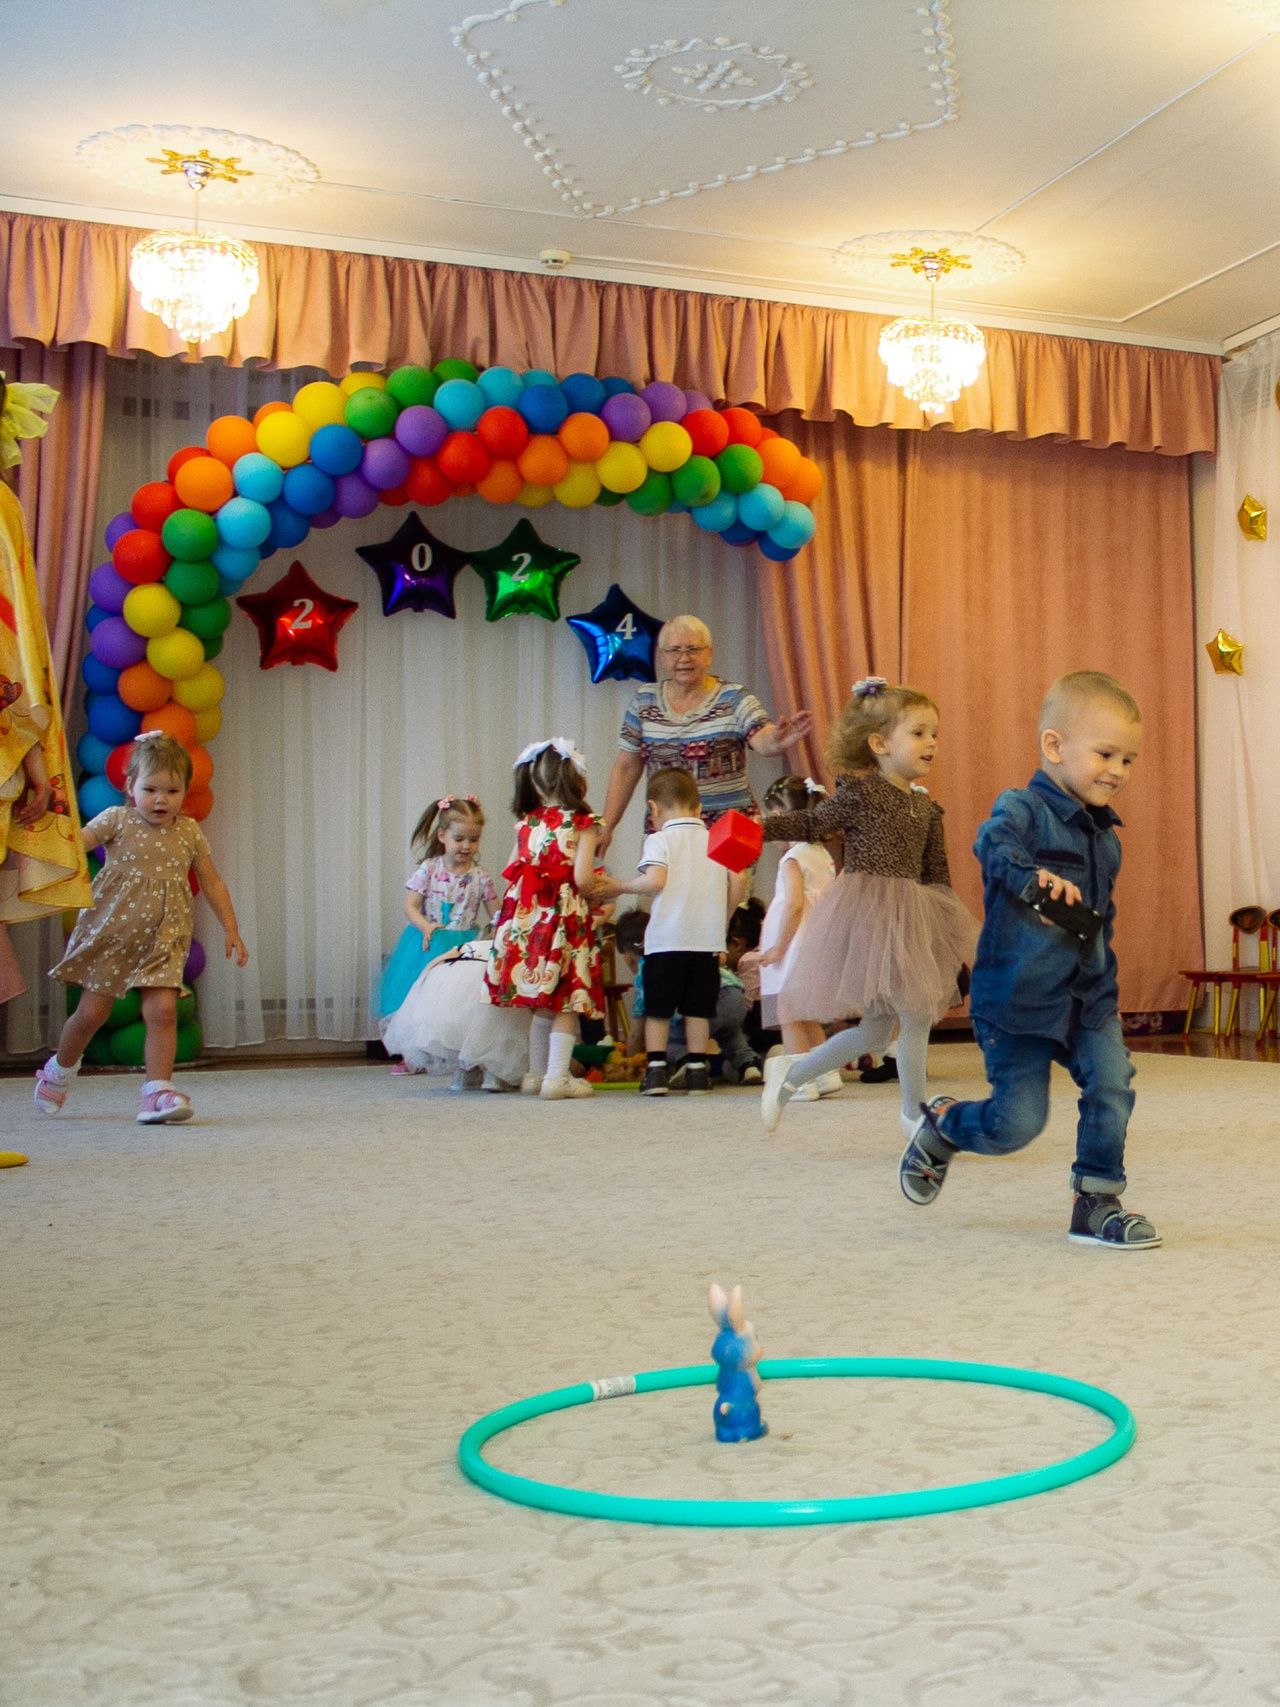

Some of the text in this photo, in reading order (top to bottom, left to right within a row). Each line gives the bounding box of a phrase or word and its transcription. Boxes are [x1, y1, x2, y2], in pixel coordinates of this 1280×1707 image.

[292, 543, 637, 640] 2 0 2 4
